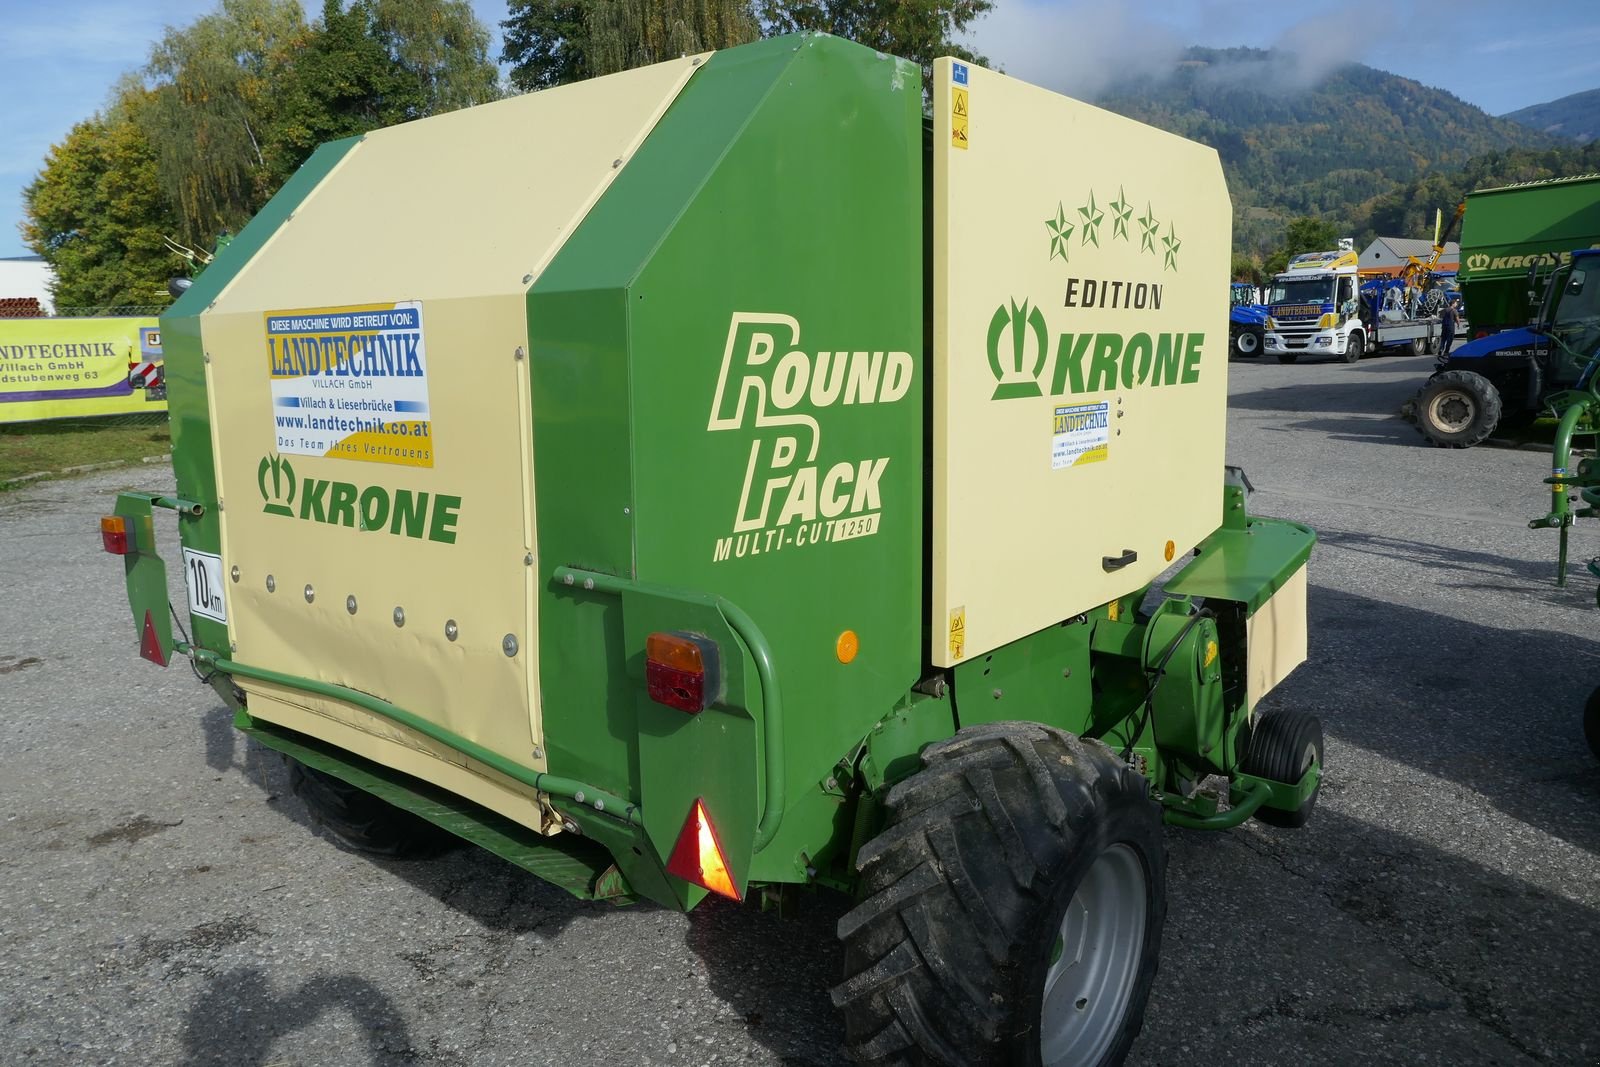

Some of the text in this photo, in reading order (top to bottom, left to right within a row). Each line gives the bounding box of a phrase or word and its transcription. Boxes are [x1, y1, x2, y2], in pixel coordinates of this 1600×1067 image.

[1064, 278, 1163, 310] EDITION
[271, 313, 413, 331] DIESE MASCHINE WIRD BETREUT VON:
[1272, 305, 1322, 316] LANDTECHNIK
[48, 361, 85, 370] GmbH
[268, 333, 423, 377] LANDTECHNIK
[1050, 332, 1205, 396] KRONE
[84, 371, 99, 379] 63
[707, 312, 914, 431] ROUND
[312, 379, 372, 389] VILLACH GmbH
[300, 397, 393, 412] Villach & Lieserbrücke
[276, 414, 428, 437] www.landtechnik.co.at
[1055, 412, 1108, 434] LANDTECHNIK
[279, 436, 429, 460] Das Team Ihres Vertrauens
[733, 414, 890, 533] PACK
[300, 478, 462, 545] KRONE
[713, 517, 873, 563] MULTI-CUT 1250
[190, 558, 223, 613] 10 km
